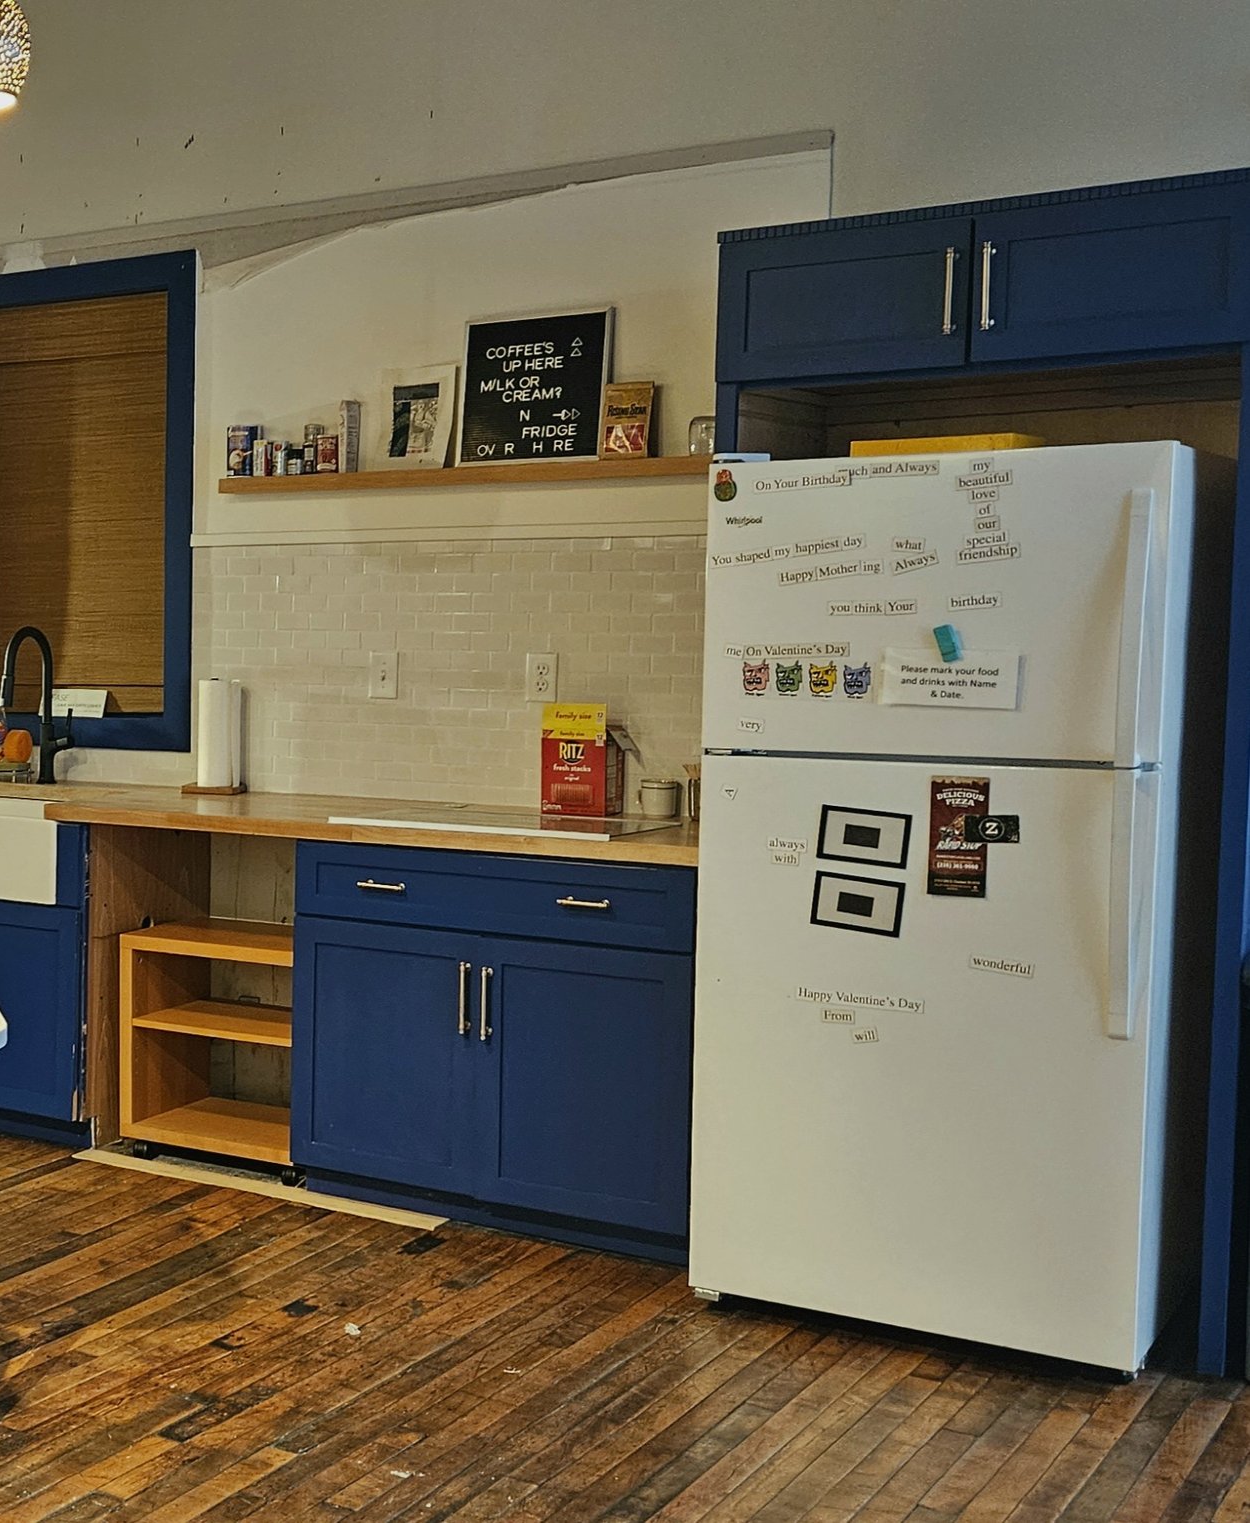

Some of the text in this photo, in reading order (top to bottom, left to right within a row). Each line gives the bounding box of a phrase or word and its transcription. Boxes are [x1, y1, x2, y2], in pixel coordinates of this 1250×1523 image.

[486, 341, 554, 359] COFFEE'S
[502, 356, 564, 373] UP HERE
[480, 376, 540, 393] MILK OR
[502, 387, 563, 403] CREAM?
[522, 423, 578, 439] FRIDGE
[872, 463, 892, 474] and
[895, 462, 938, 475] Always
[973, 460, 991, 473] my
[755, 473, 847, 491] On Your Birthday
[958, 472, 1010, 488] beautiful
[971, 489, 996, 501] love
[978, 504, 991, 516] of
[725, 515, 763, 528] Whirlpool
[977, 520, 997, 530] our
[895, 540, 922, 551] what
[966, 532, 1007, 549] special
[712, 535, 863, 566] You shaped my happiest day
[958, 543, 1018, 562] friendship
[894, 554, 936, 572] Always
[780, 561, 881, 584] Happy Mother ing
[951, 594, 999, 609] birthday
[830, 601, 915, 616] you think Your
[726, 644, 847, 657] me On Valentine's Day
[901, 665, 1000, 677] Please mark your food
[900, 677, 998, 689] and drinks with Name
[930, 690, 938, 699] &
[740, 720, 762, 733] very
[559, 742, 585, 760] RITZ
[552, 763, 592, 773] fresh stacks
[936, 791, 986, 802] DELICIOUS
[945, 798, 975, 807] PIZZA
[985, 822, 999, 835] Z
[769, 837, 806, 852] always
[774, 853, 797, 864] with
[972, 957, 1032, 975] wonderful
[798, 987, 922, 1012] Happy Valentine's Day
[823, 1010, 853, 1022] From
[854, 1030, 876, 1042] will
